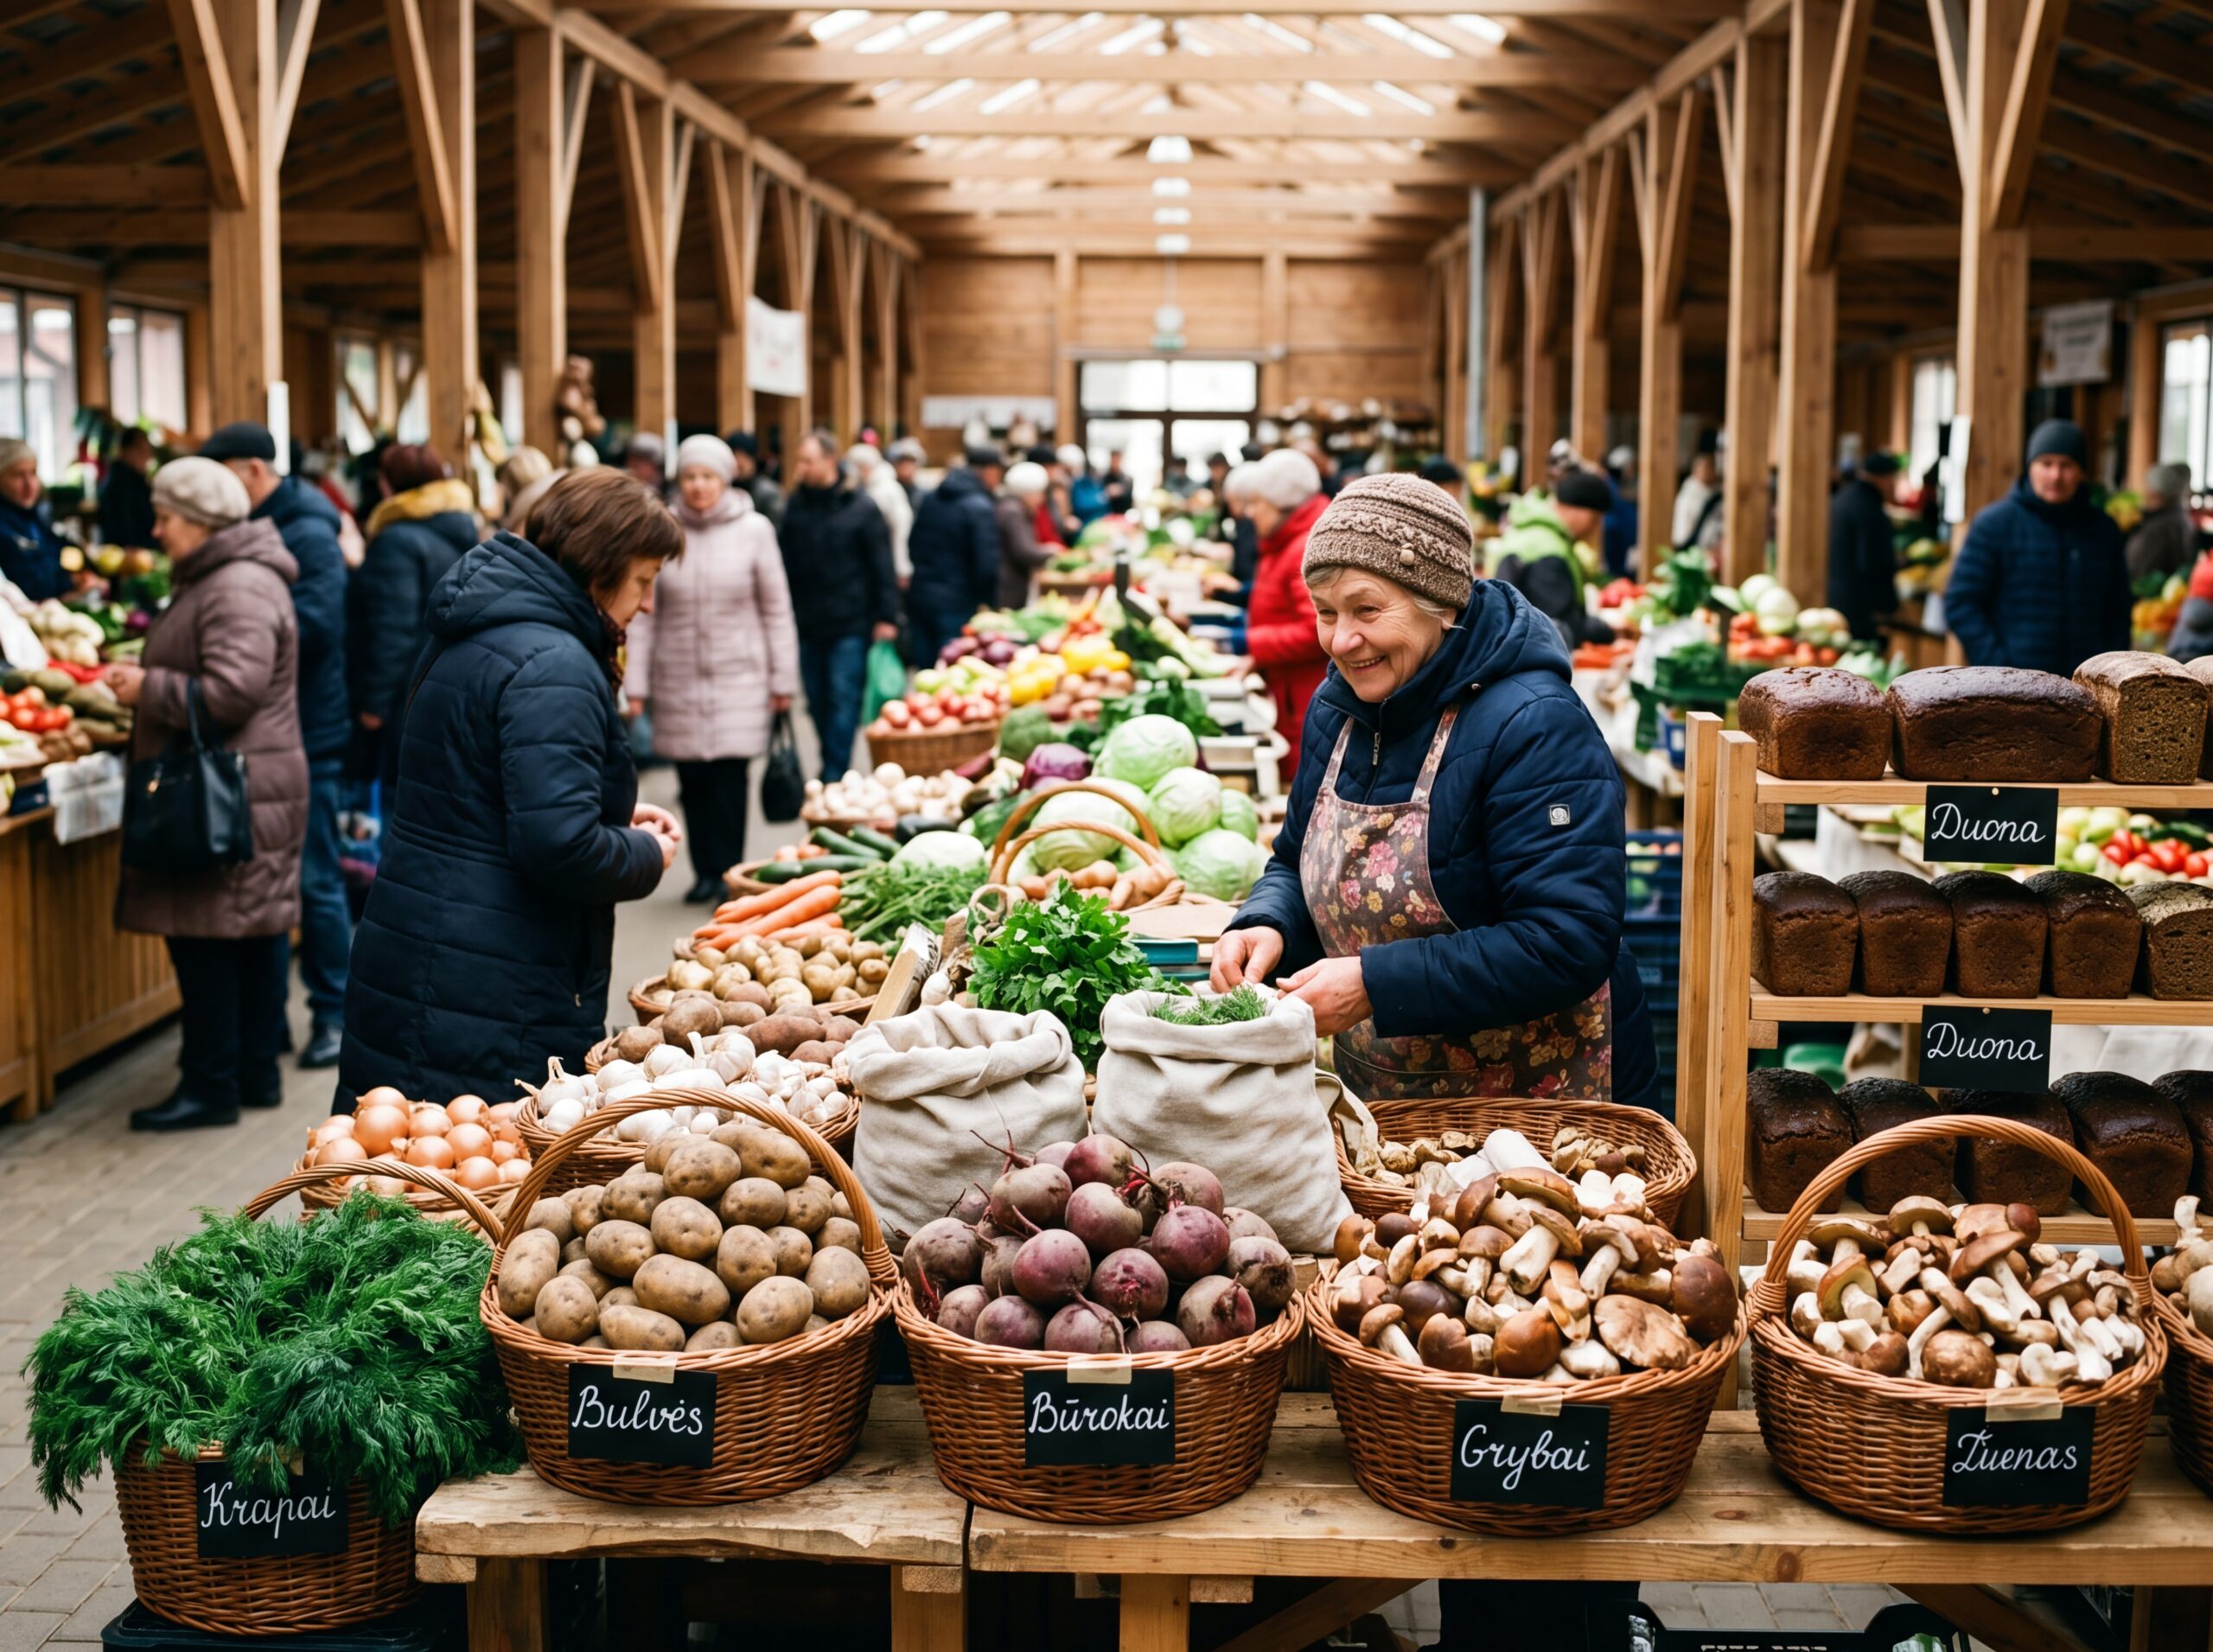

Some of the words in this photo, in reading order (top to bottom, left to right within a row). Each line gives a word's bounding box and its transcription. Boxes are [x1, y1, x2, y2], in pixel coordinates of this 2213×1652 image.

[1930, 802, 2047, 843] Duona
[1927, 1022, 2044, 1061] Duona
[571, 1384, 704, 1436] Bulvės
[1028, 1390, 1170, 1434] Būrokai
[1460, 1423, 1591, 1491] Grybai
[200, 1480, 337, 1540] Krapai
